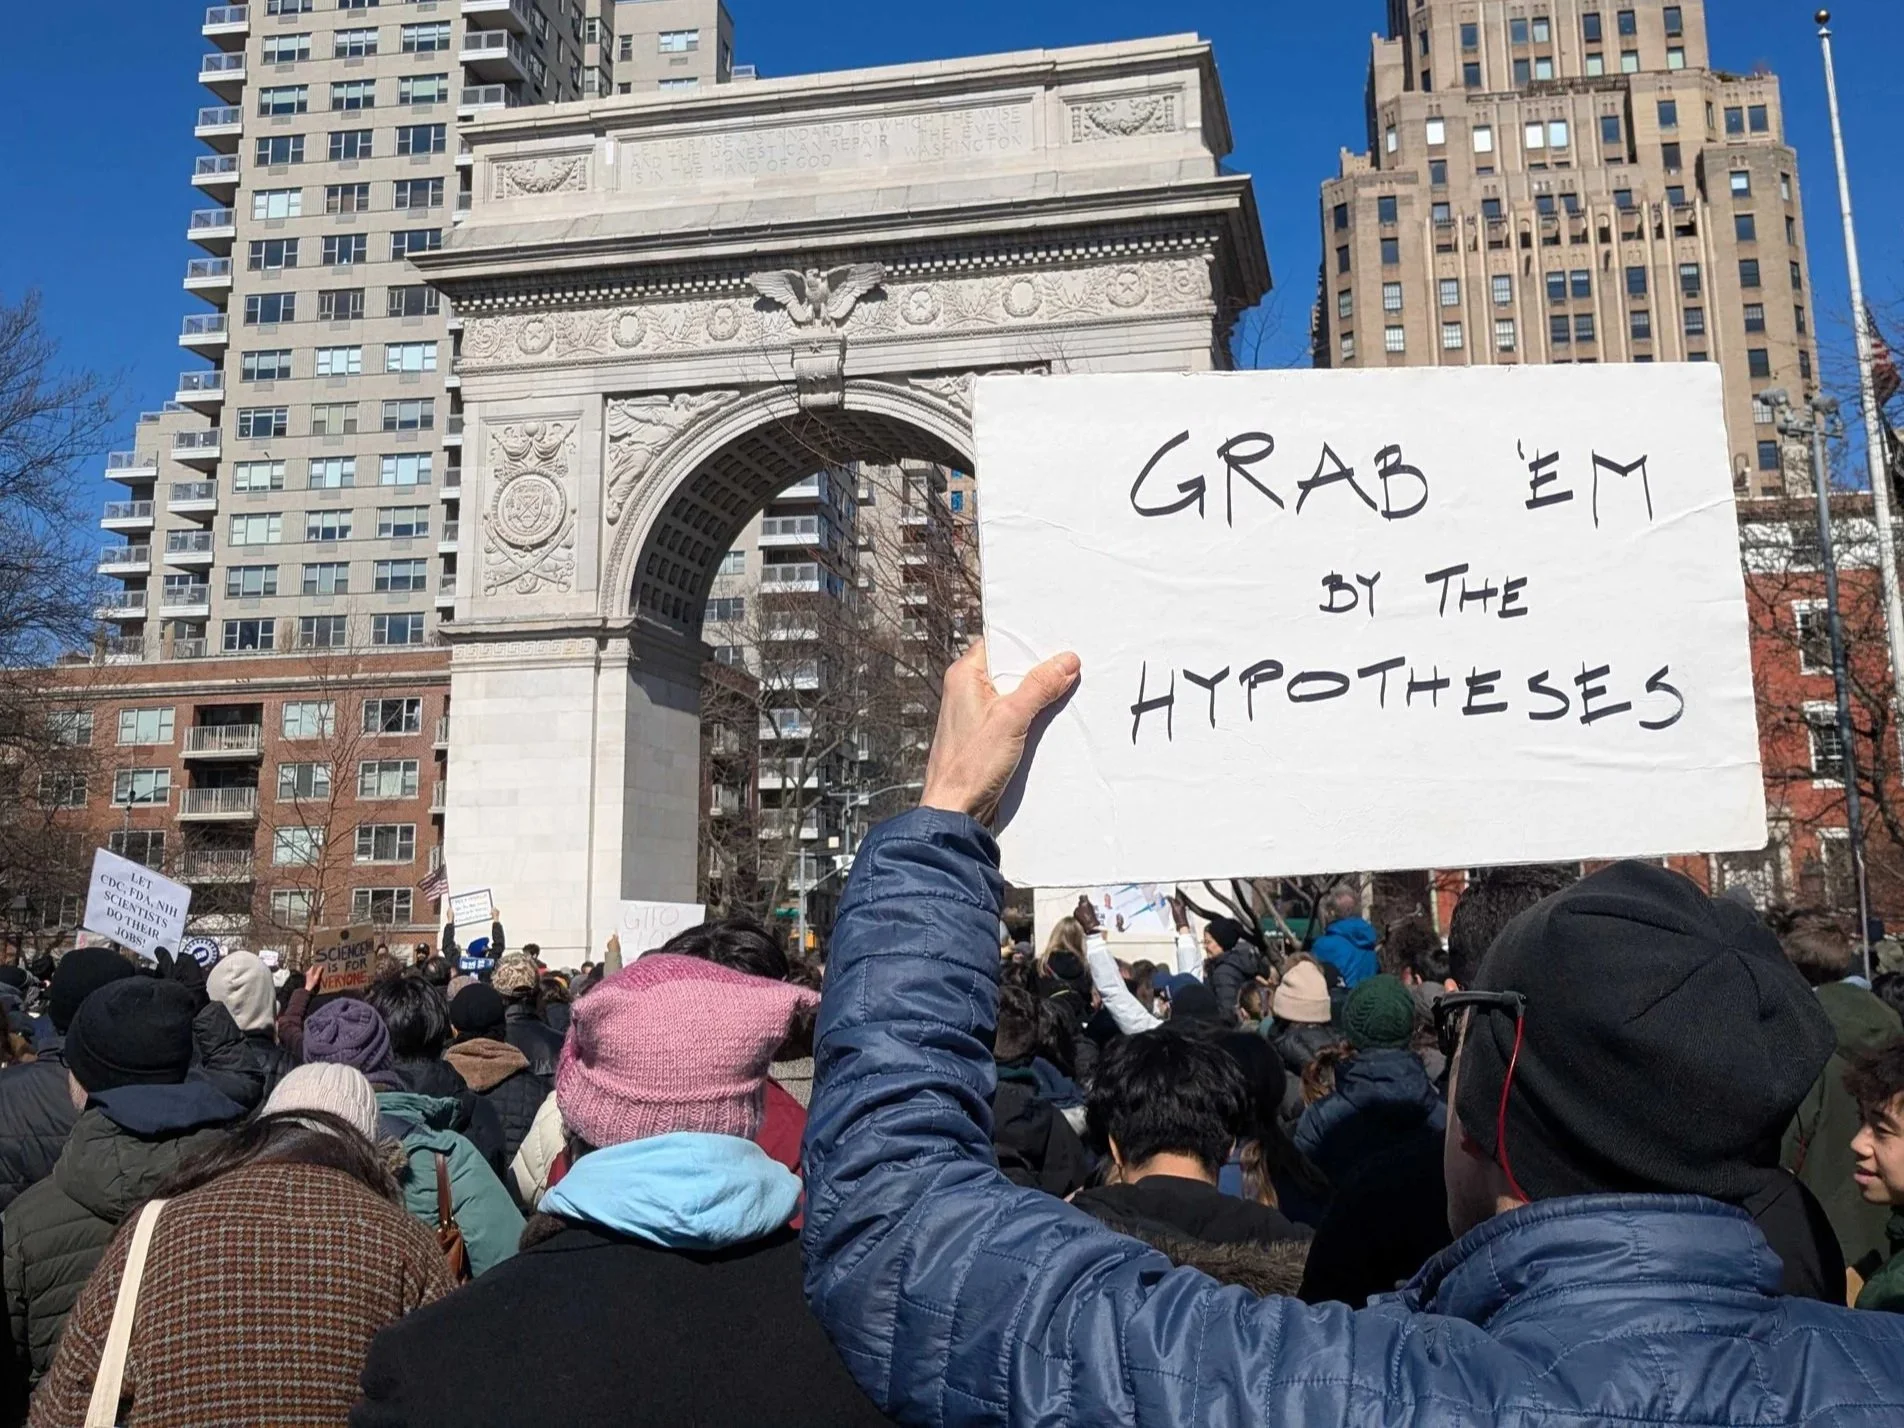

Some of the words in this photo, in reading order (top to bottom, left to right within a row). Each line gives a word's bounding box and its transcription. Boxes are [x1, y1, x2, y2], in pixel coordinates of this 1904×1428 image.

[795, 152, 833, 169] GOD
[903, 134, 1023, 158] WASHINGTON
[1131, 431, 1427, 527] GRAB
[1518, 440, 1652, 527] 'EM
[1320, 571, 1380, 617] BY
[1425, 564, 1527, 618] THE
[1131, 657, 1683, 744] HYPOTHESES
[100, 874, 126, 895] CDC,
[129, 887, 154, 908] FDA,
[157, 899, 179, 918] NIH
[131, 872, 153, 890] LET
[104, 890, 168, 928] SCIENTISTS
[106, 907, 123, 921] DO
[124, 915, 160, 940] THEIR
[114, 926, 146, 948] JOBS!
[319, 970, 368, 989] VERYONE
[345, 958, 368, 971] FOR
